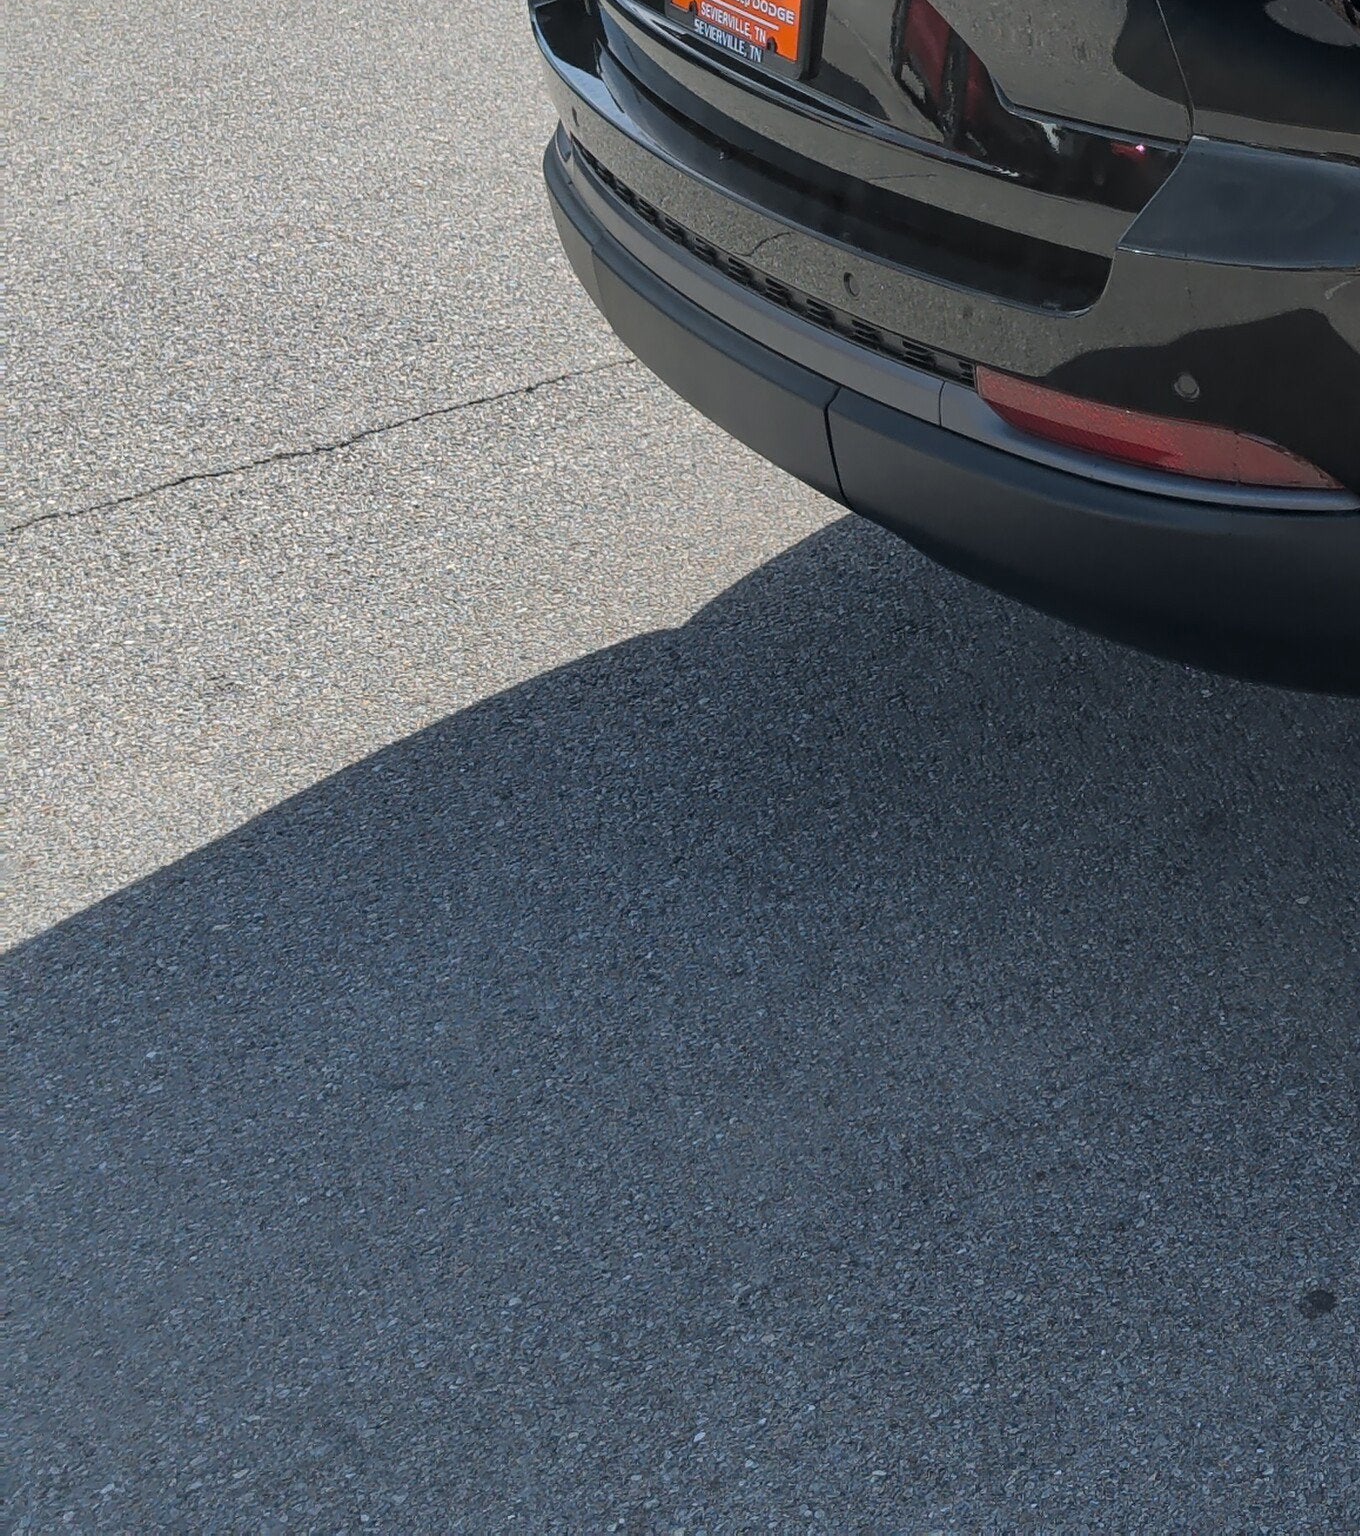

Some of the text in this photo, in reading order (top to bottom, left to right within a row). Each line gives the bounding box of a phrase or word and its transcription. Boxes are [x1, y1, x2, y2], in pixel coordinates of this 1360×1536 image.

[694, 19, 762, 63] SEVIERVILLE, TN
[701, 2, 766, 44] SEVIERVILLE, TN
